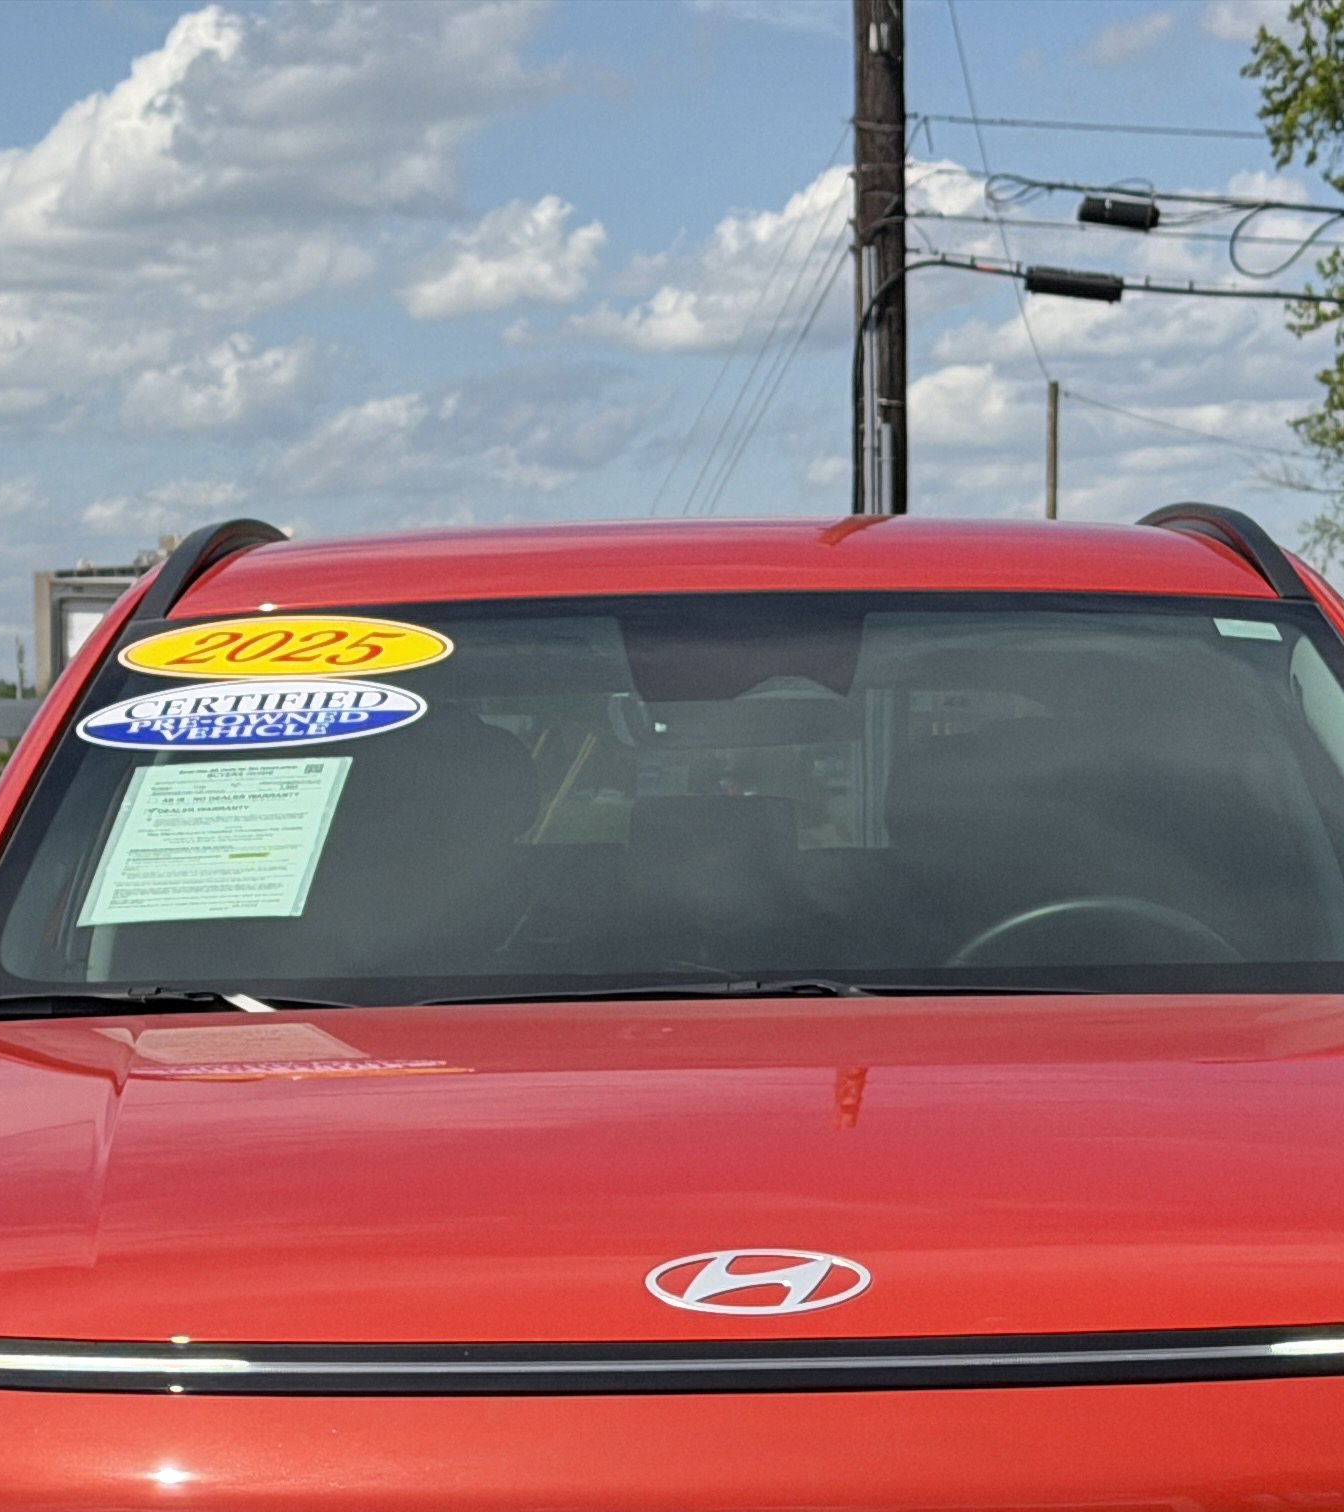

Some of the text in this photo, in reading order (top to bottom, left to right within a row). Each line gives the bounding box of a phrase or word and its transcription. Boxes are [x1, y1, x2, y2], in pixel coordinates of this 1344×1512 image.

[164, 629, 406, 666] 2025
[126, 691, 388, 720] CERTIFIED
[126, 709, 370, 734] PRE-OWNED
[160, 722, 331, 741] VEHICLE
